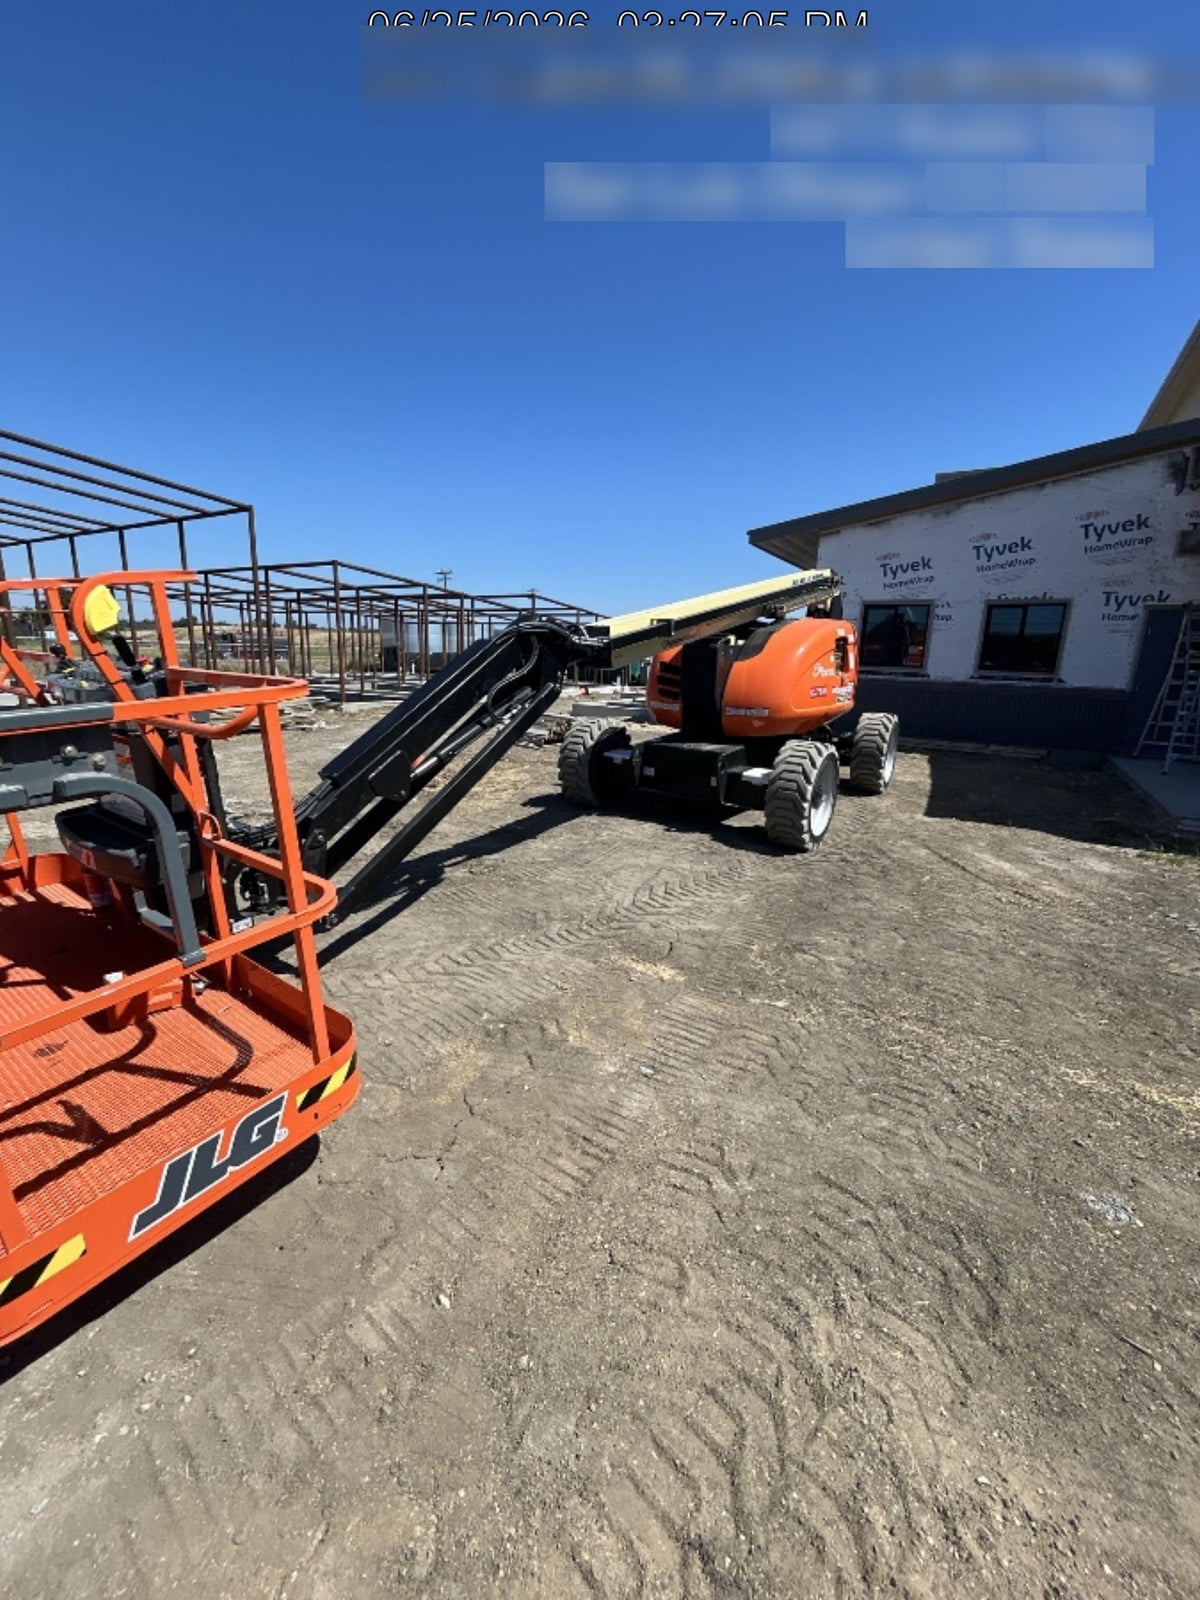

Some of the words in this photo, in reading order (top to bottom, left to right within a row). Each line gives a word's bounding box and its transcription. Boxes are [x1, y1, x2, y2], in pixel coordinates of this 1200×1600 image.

[1080, 513, 1150, 542] Tyvek
[972, 536, 1033, 562] Tyvek
[880, 556, 933, 580] Tyvek
[127, 1090, 288, 1243] JLG
